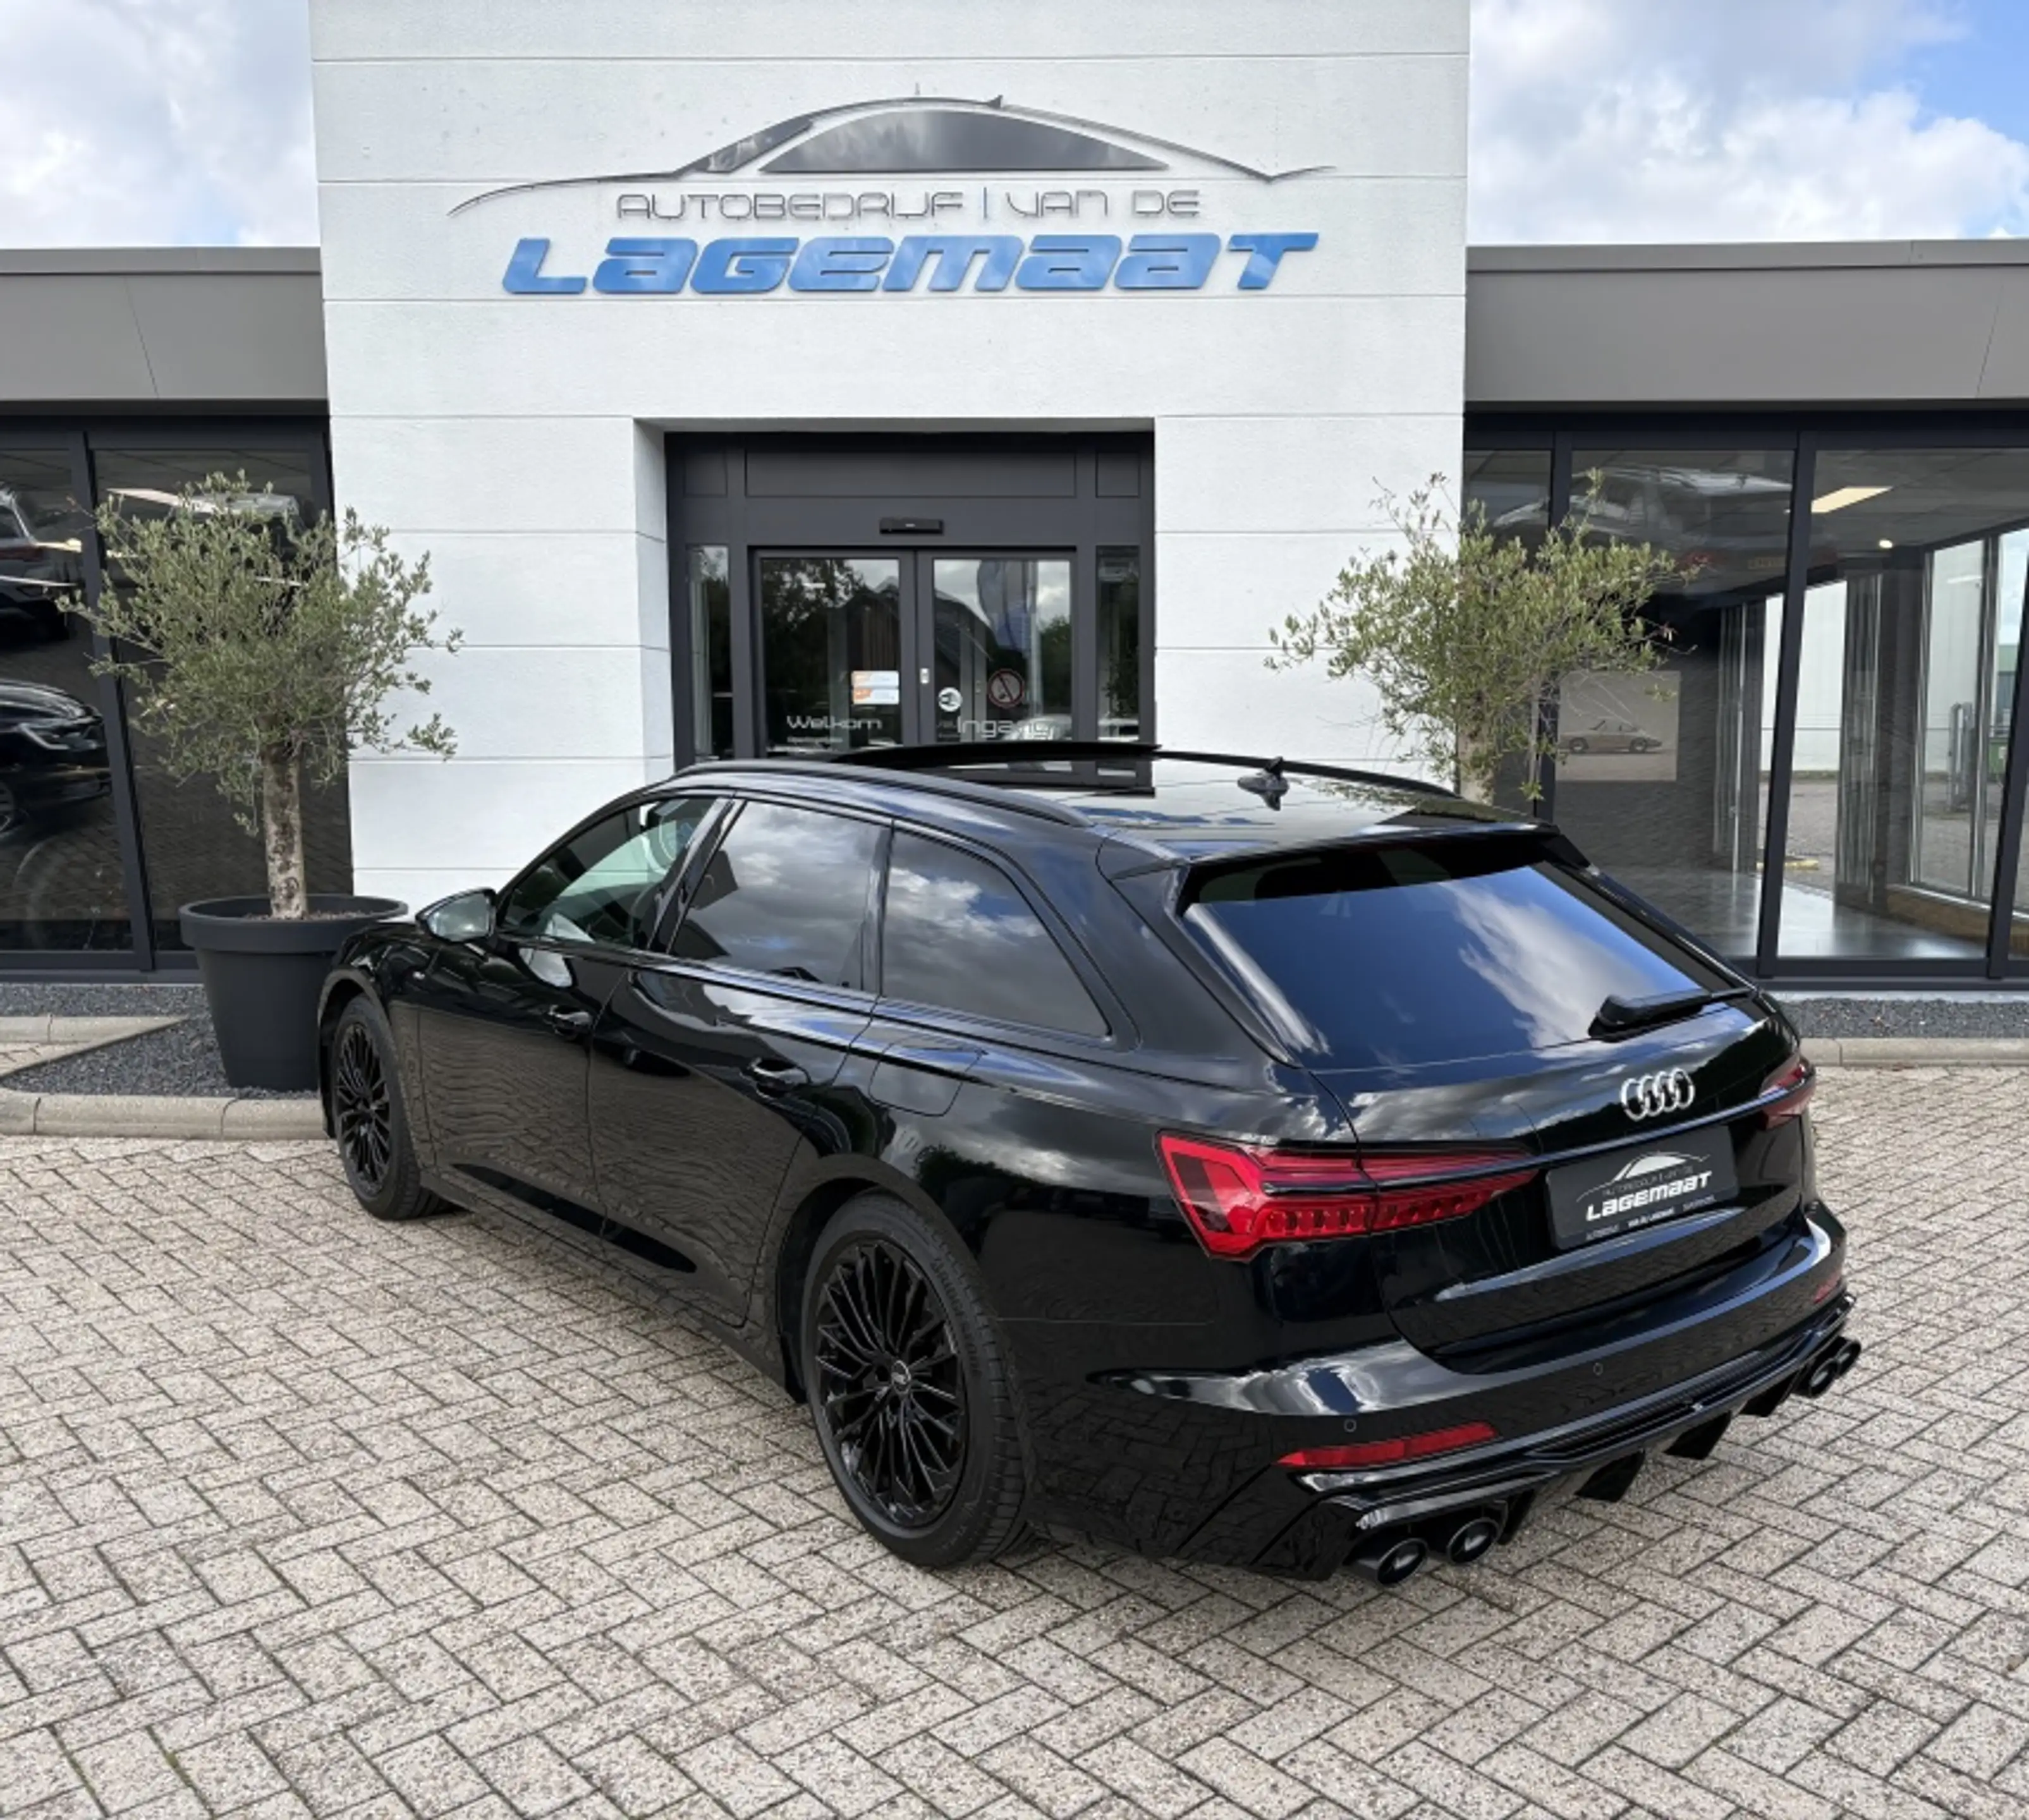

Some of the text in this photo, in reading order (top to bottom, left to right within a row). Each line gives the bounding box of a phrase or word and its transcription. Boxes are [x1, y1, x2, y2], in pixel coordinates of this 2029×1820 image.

[617, 189, 1200, 221] AUTOBEDRIJF VAN DE
[786, 715, 882, 730] Welkom
